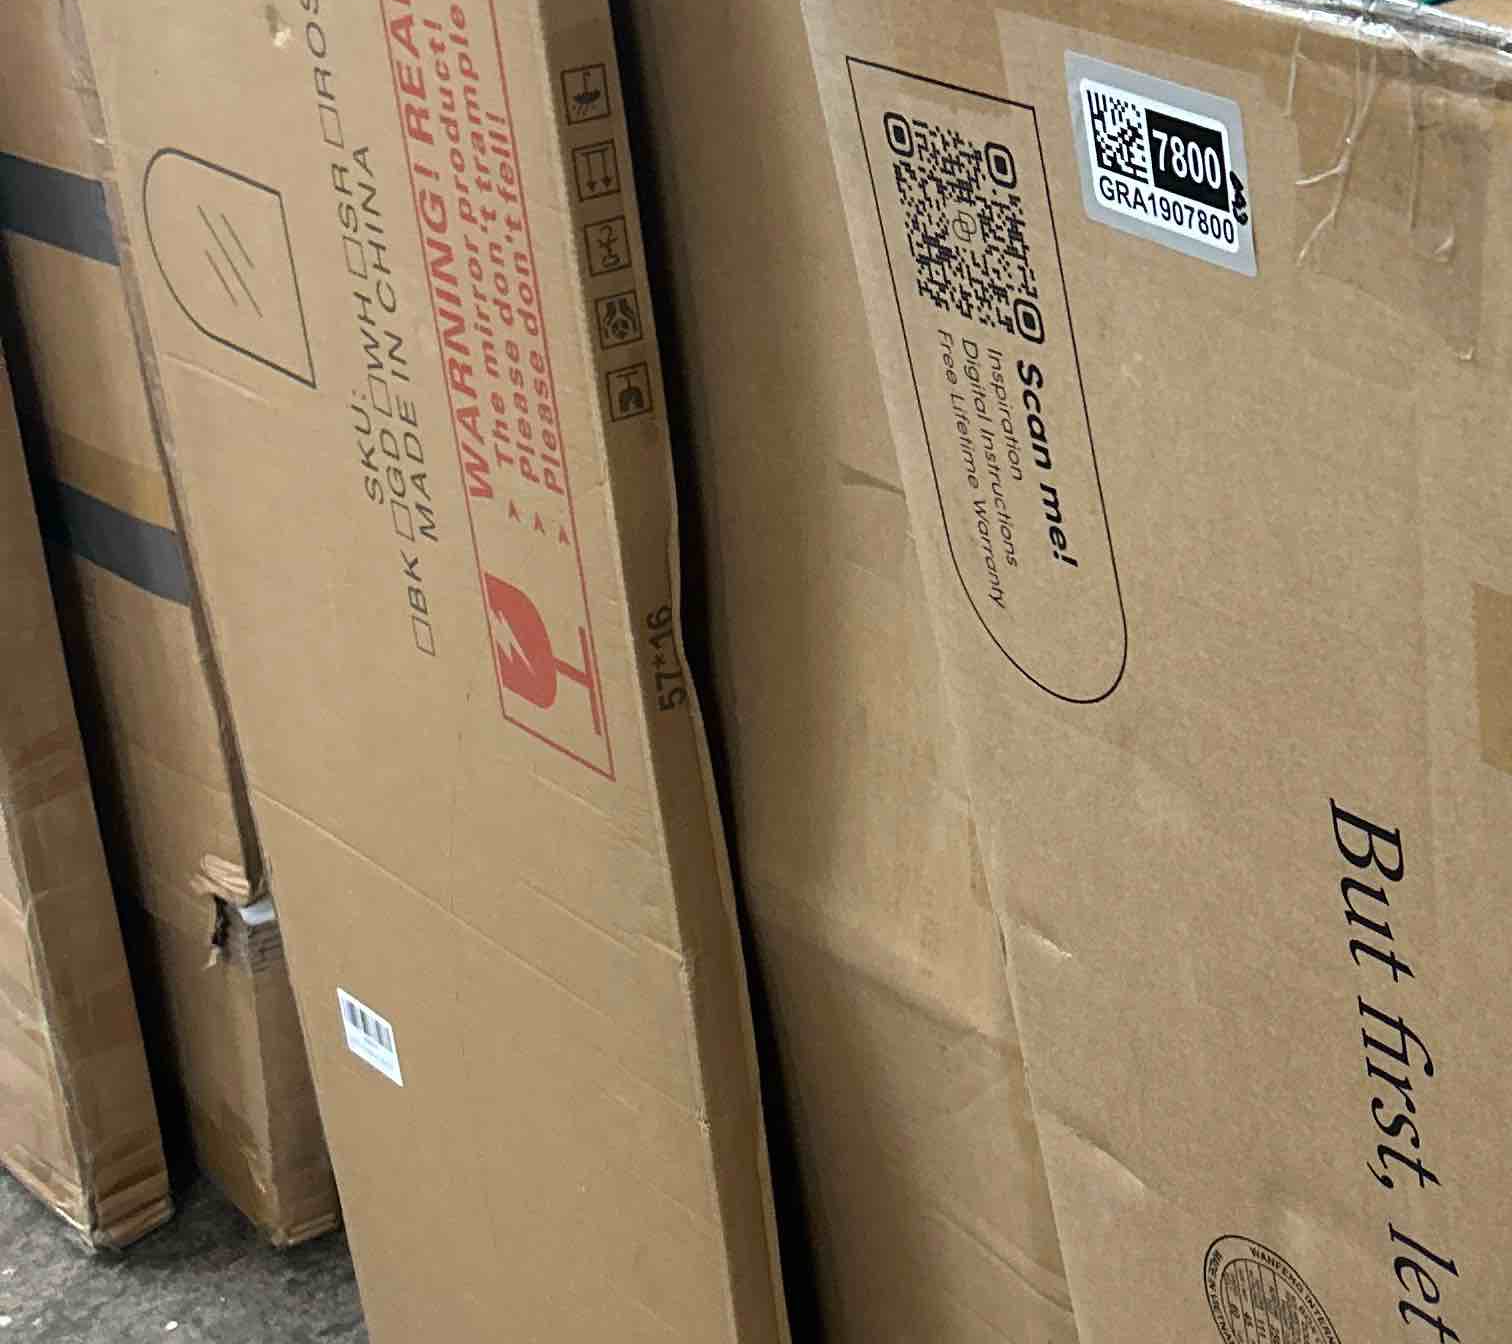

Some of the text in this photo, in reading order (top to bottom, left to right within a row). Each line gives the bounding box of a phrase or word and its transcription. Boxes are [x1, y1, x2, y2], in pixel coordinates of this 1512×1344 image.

[331, 162, 359, 233] SR
[1099, 175, 1235, 244] GRA1907800
[1152, 129, 1221, 189] 7800
[423, 18, 514, 468] The mirror product!
[479, 208, 515, 327] don't
[504, 216, 541, 338] don't
[353, 290, 384, 371] WH
[353, 146, 438, 543] MADE IN CHINA
[413, 161, 493, 499] WARNING!
[351, 389, 384, 505] SKU:
[380, 429, 407, 499] GD
[506, 339, 541, 485] Please
[529, 350, 566, 496] Please
[937, 329, 1006, 609] Free Lifetime Warranty
[962, 337, 1018, 569] Digital Instructions
[986, 347, 1023, 481] Inspiration
[1016, 359, 1079, 568] Scan me!
[399, 551, 428, 615] BK
[1329, 797, 1416, 984] But
[1358, 994, 1441, 1190] first,
